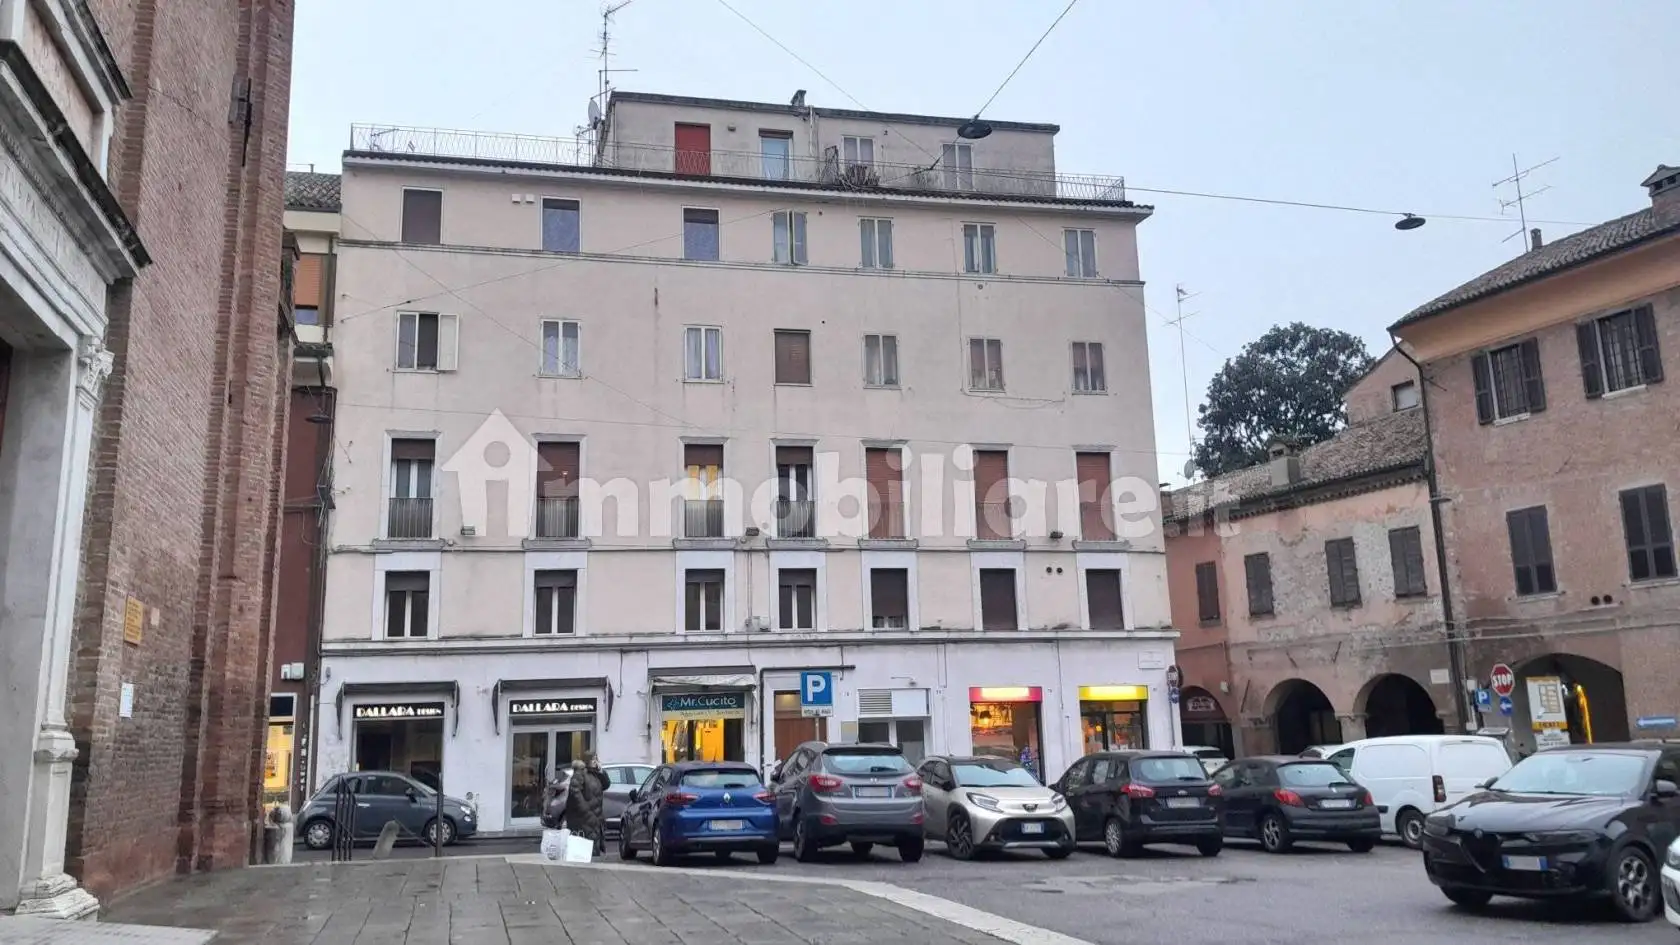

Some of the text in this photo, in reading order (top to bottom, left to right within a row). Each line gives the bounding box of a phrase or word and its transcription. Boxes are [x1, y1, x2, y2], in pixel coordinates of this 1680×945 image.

[1492, 673, 1513, 687] STOP
[806, 674, 826, 702] P
[1479, 691, 1488, 703] P
[356, 706, 415, 717] DALLARA
[512, 702, 568, 713] DALLARA
